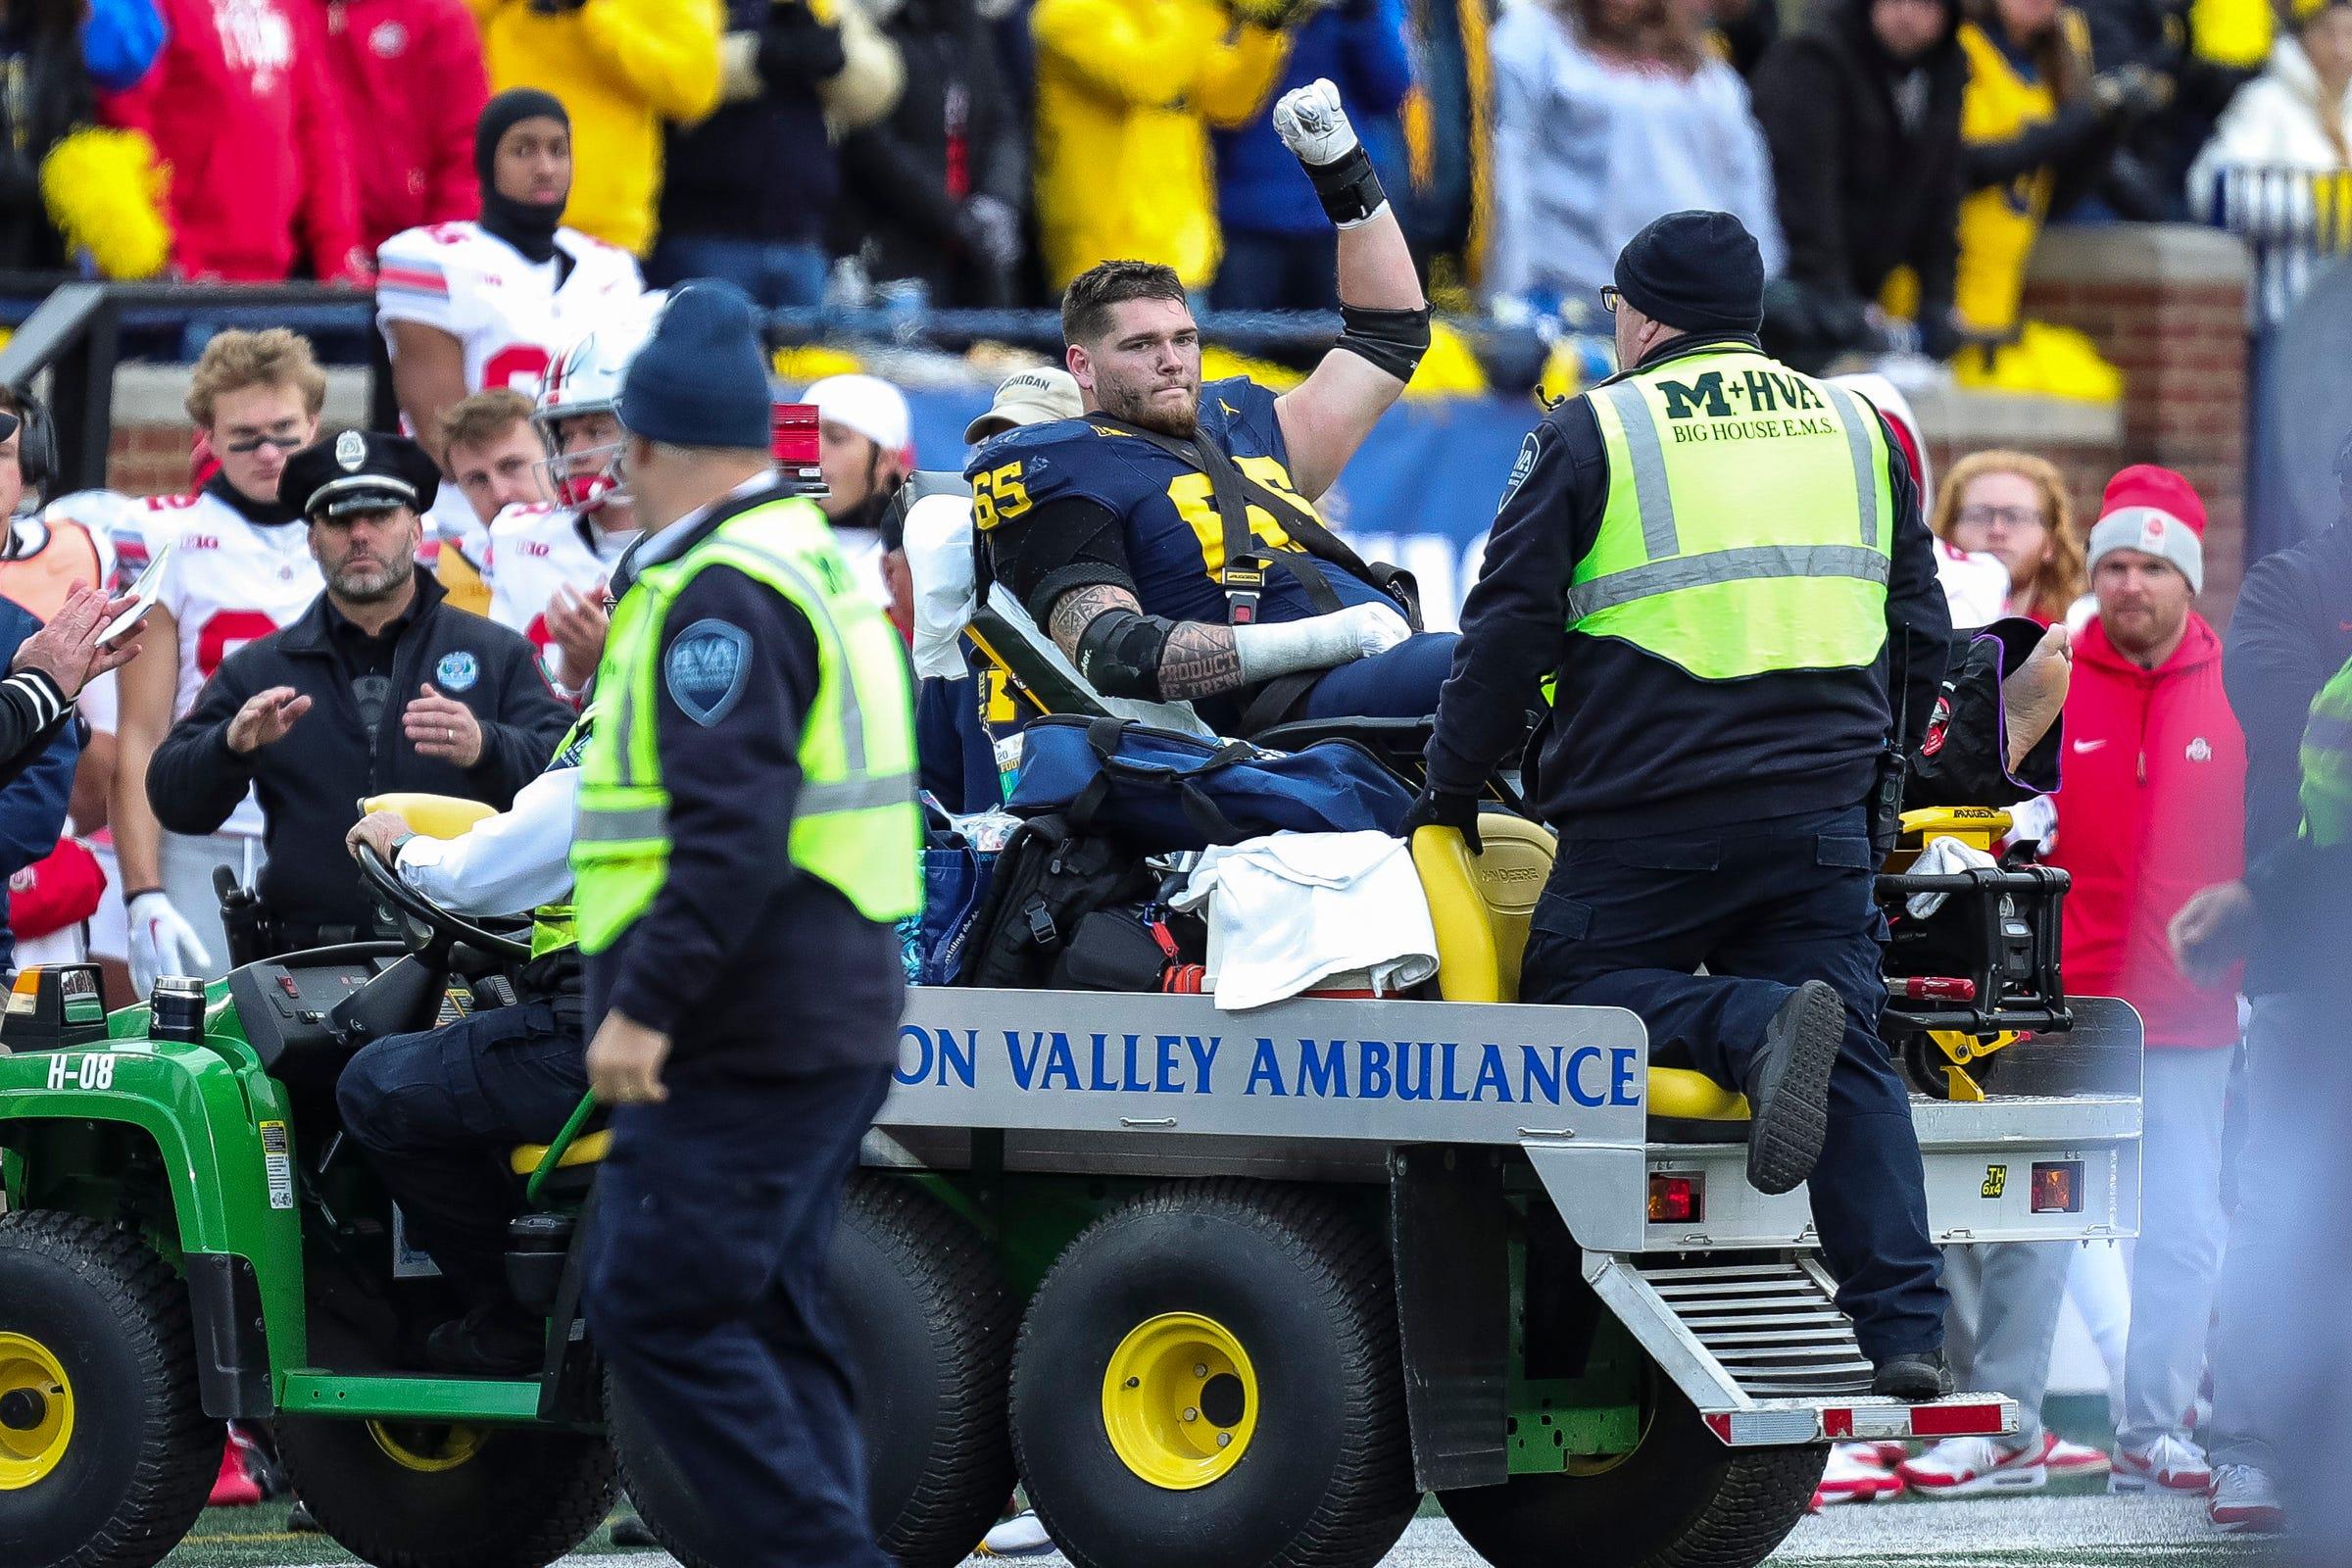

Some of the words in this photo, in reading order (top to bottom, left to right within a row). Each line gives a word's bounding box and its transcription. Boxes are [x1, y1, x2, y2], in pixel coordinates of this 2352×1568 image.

[1673, 424, 1708, 443] BIG
[1711, 419, 1781, 441] HOUSE
[1782, 416, 1838, 437] E.M.S.
[972, 460, 1032, 531] 65
[1158, 650, 1238, 682] PRODUCT
[47, 1053, 116, 1090] H-08
[1002, 1029, 1223, 1095] VALLEY
[1241, 1036, 1642, 1109] AMBULANCE
[1982, 1182, 2002, 1196] 6x4
[1987, 1167, 2006, 1184] TH
